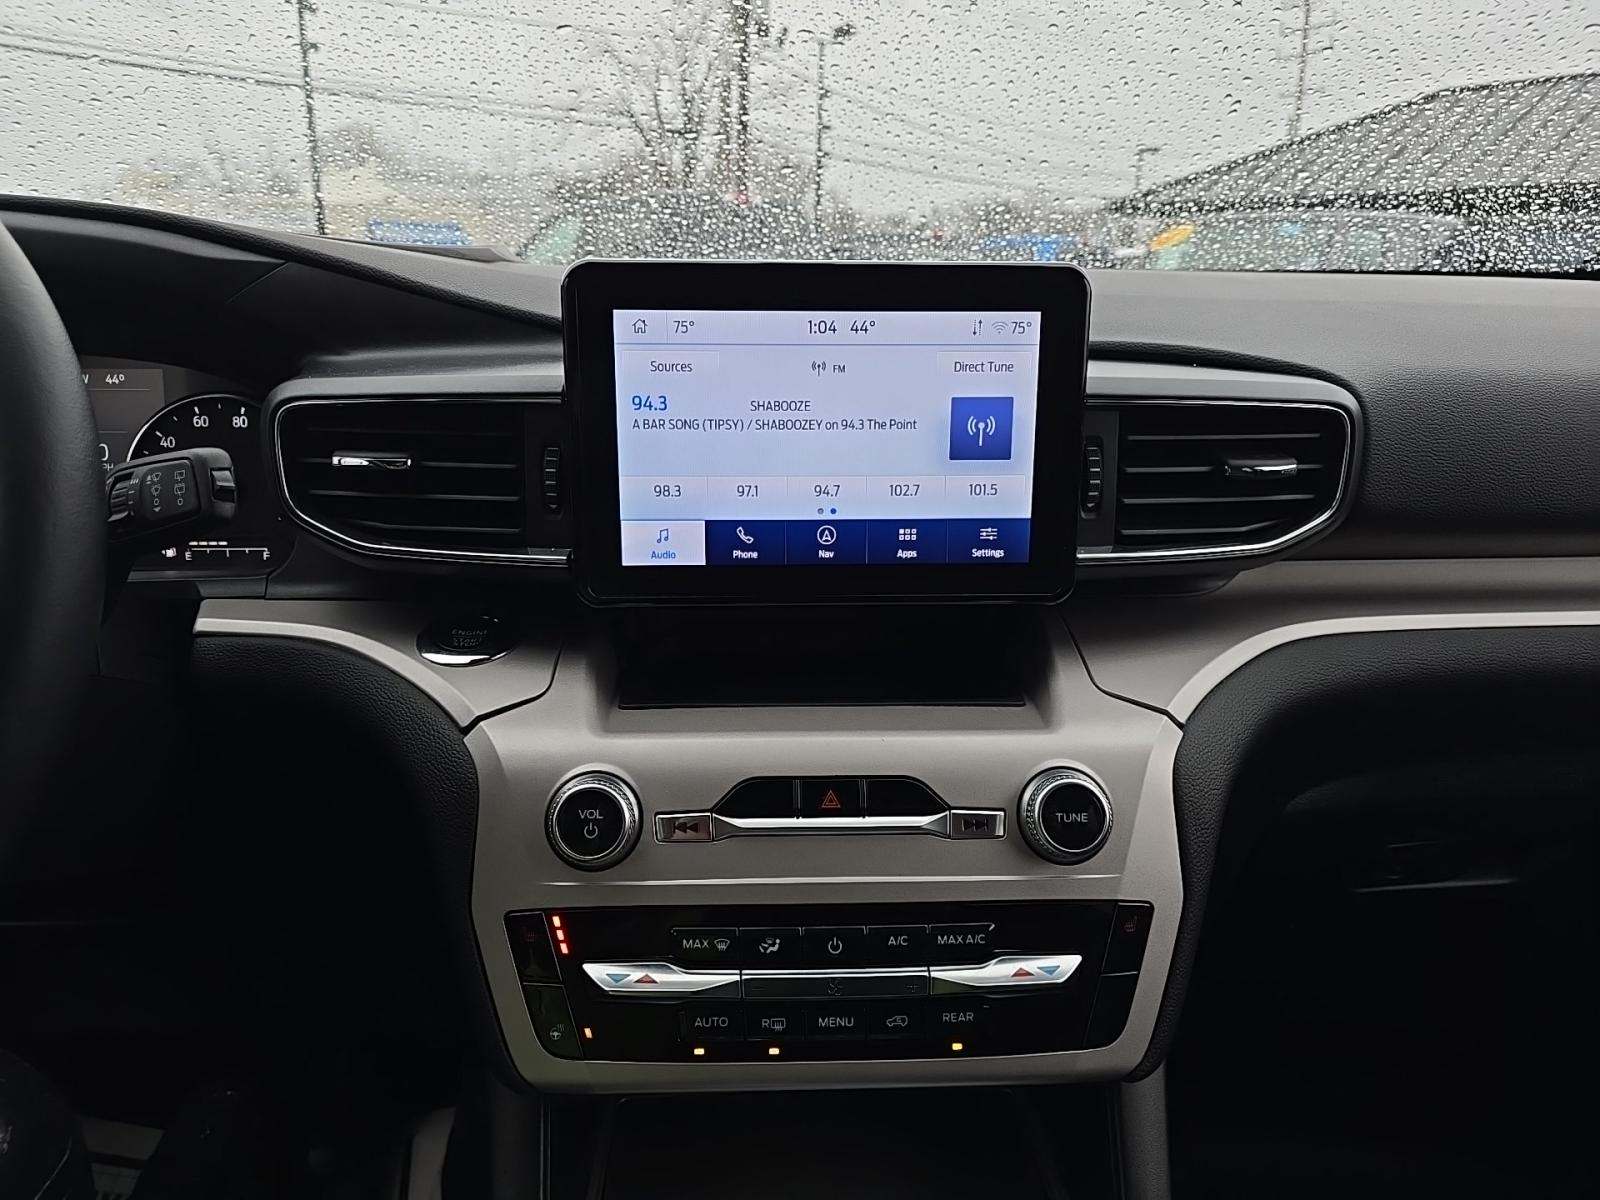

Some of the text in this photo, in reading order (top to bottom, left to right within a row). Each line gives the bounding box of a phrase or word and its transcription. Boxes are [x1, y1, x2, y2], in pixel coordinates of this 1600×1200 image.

[672, 320, 695, 334] 75°
[807, 320, 876, 334] 1:04 44°
[1011, 321, 1033, 335] 75°
[650, 360, 693, 373] Sources
[832, 364, 846, 373] FM
[954, 361, 1014, 373] Direct Tune
[631, 395, 668, 411] 94.3
[750, 400, 811, 412] SHABOOZE
[193, 415, 209, 428] 60
[232, 415, 248, 428] 80
[632, 419, 640, 430] A
[643, 419, 666, 430] BAR
[669, 419, 700, 430] SONG
[702, 418, 744, 432] (TIPSY)
[755, 418, 823, 431] SHABOOZEY
[825, 420, 839, 430] on
[841, 419, 865, 430] 94.3
[867, 418, 887, 430] The
[889, 418, 918, 430] Point
[160, 436, 176, 448] 40
[653, 485, 681, 497] 98.3
[736, 485, 759, 497] 97.1
[814, 484, 840, 497] 94.7
[889, 484, 920, 496] 102.7
[969, 484, 998, 496] 101.5
[651, 551, 676, 559] Audio
[733, 550, 758, 559] Phone
[818, 550, 834, 558] Nav
[896, 549, 917, 559] Apps
[972, 548, 1005, 558] Settings
[578, 809, 603, 820] VOL
[1055, 812, 1089, 823] TUNE
[682, 939, 710, 949] MAX
[888, 935, 908, 946] A/C
[937, 934, 986, 945] MAX A/C
[694, 1017, 729, 1027] AUTO
[818, 1016, 854, 1028] MENU
[942, 1012, 975, 1023] REAR
